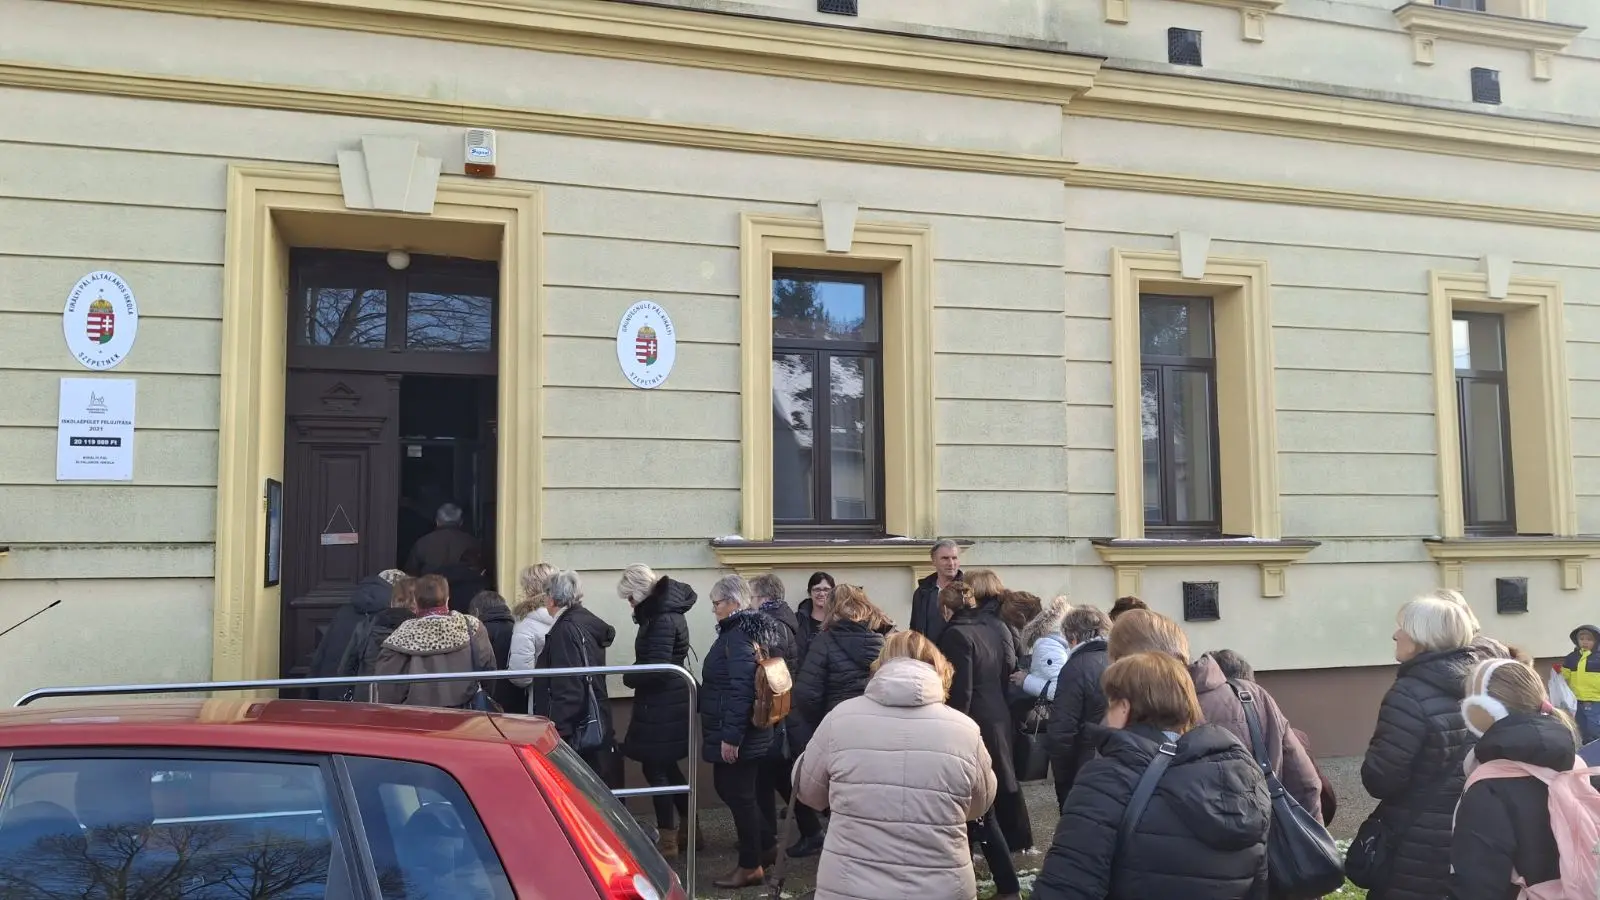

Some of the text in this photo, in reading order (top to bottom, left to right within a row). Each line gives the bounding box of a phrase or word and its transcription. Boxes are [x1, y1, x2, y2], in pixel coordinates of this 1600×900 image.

[123, 293, 134, 315] ISKOLA
[78, 351, 120, 367] SZEPETNEK
[630, 371, 663, 385] SZEPETNEK
